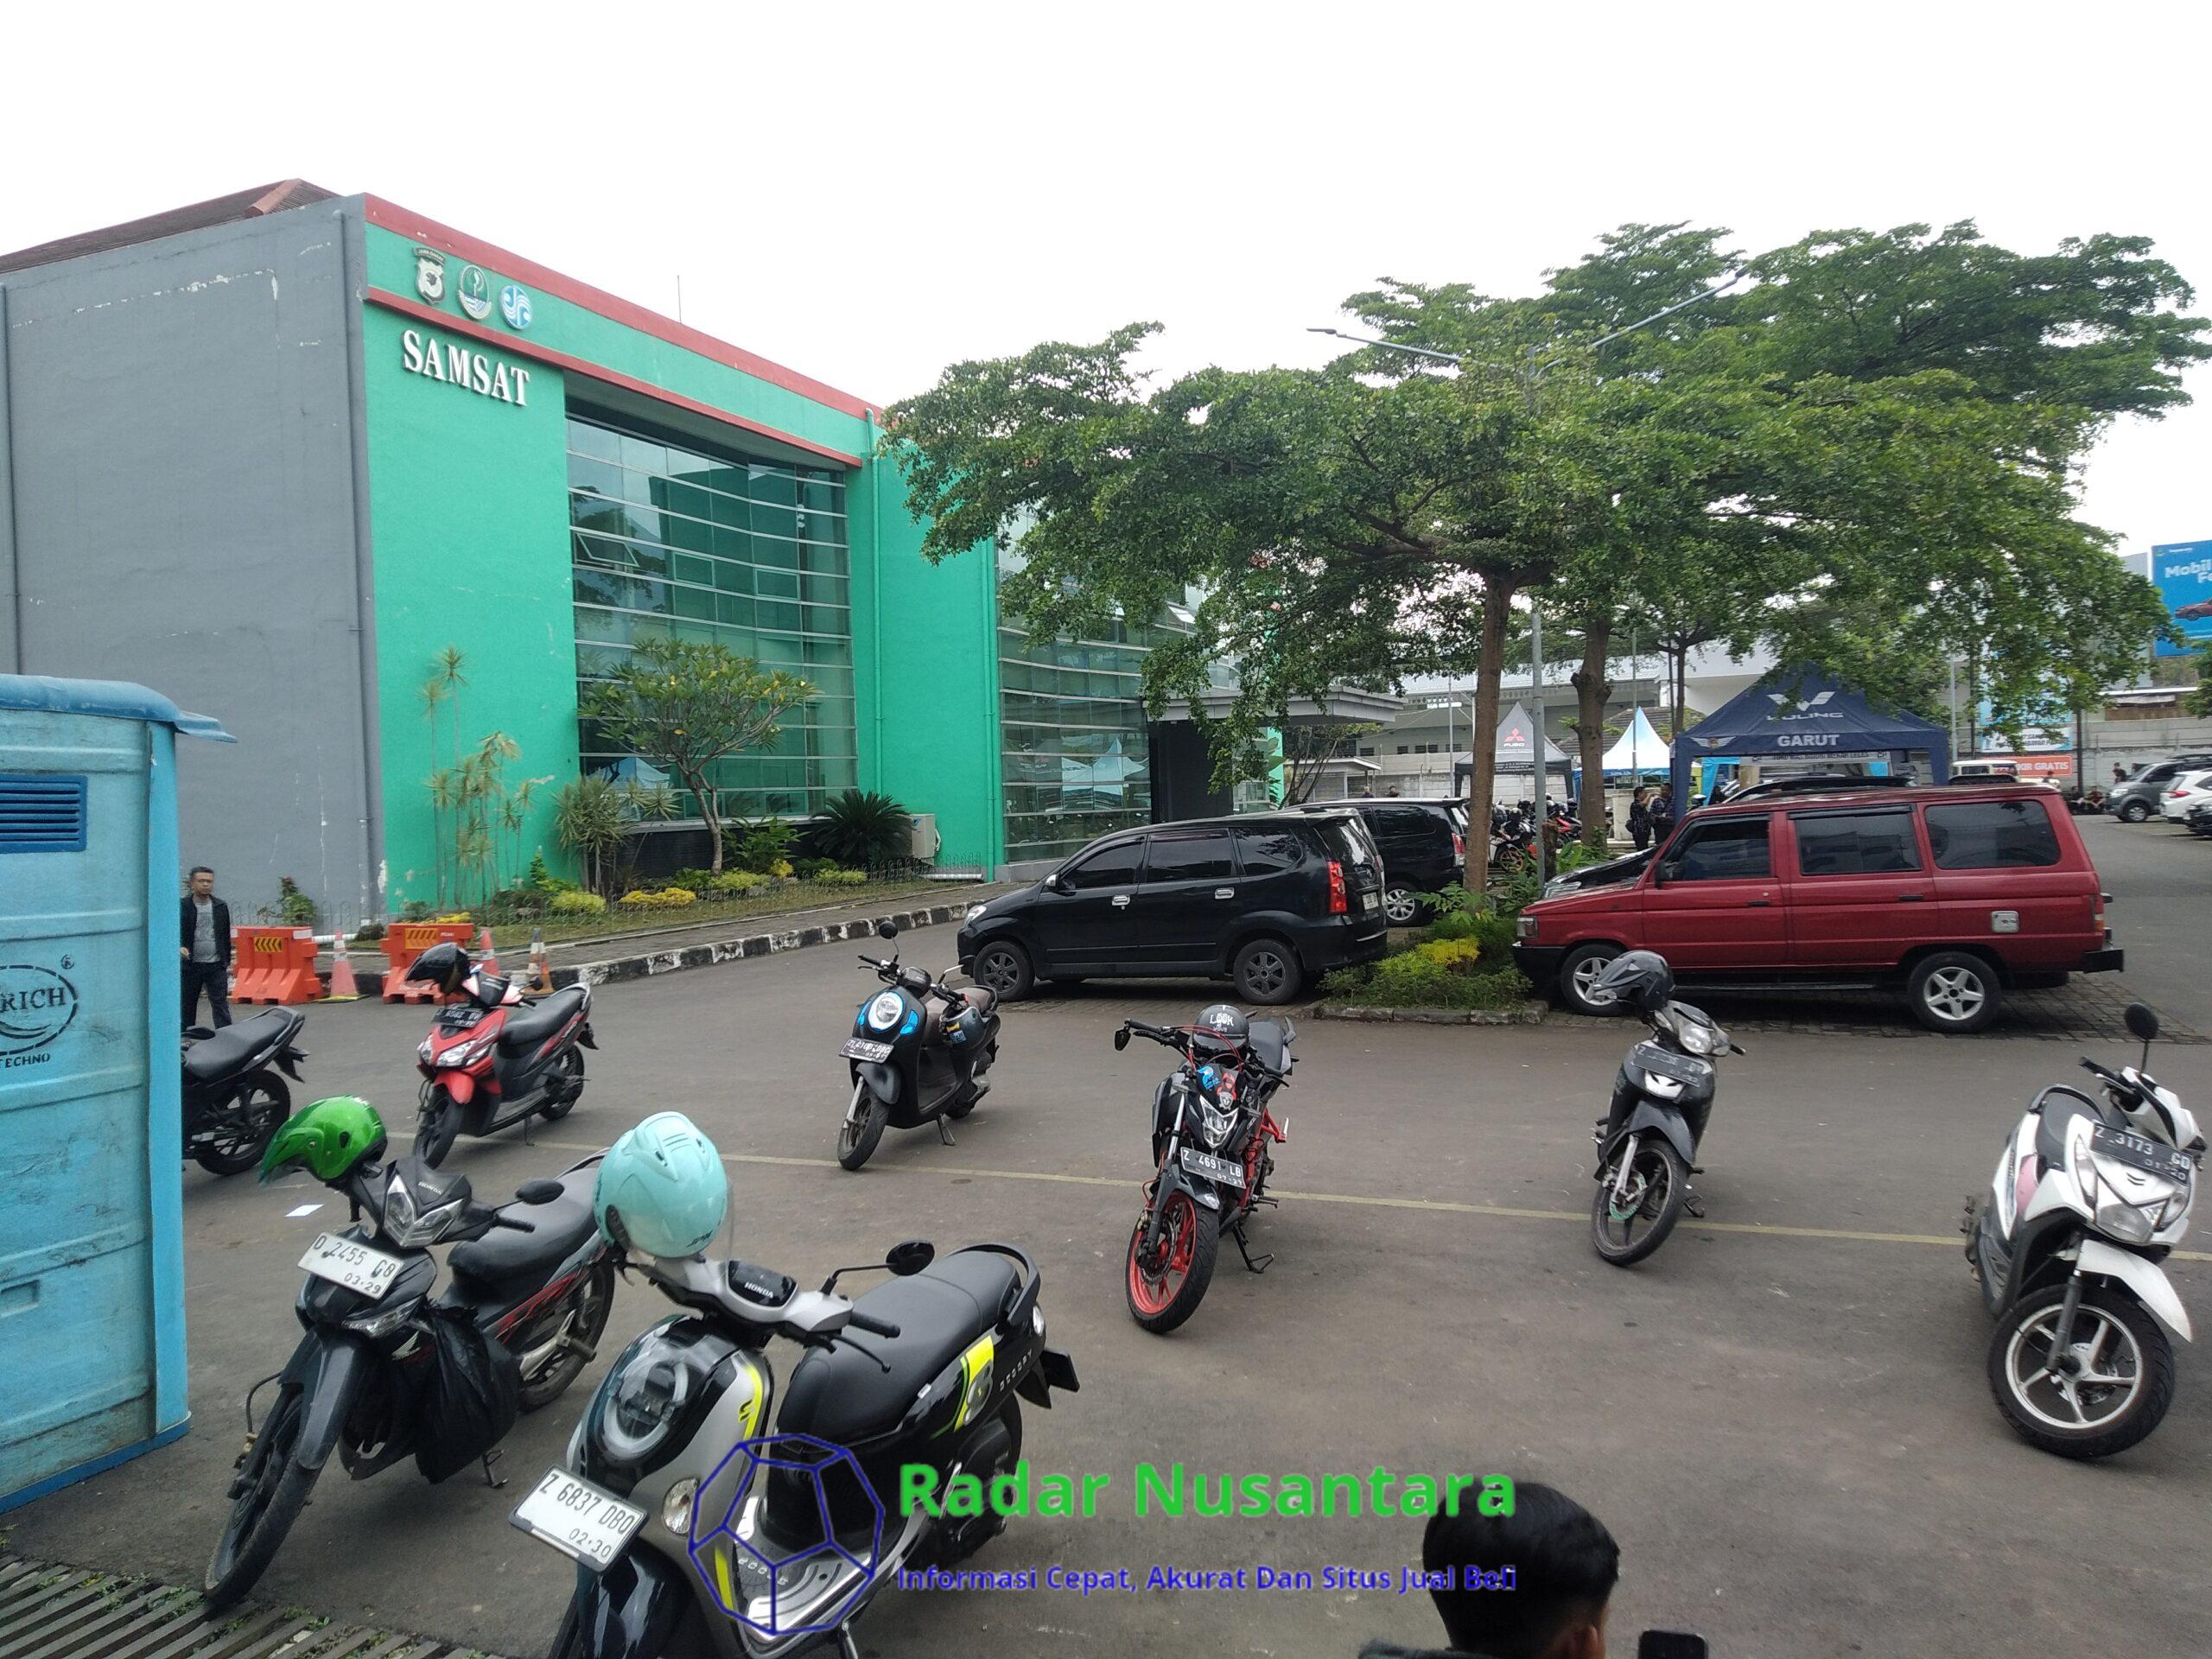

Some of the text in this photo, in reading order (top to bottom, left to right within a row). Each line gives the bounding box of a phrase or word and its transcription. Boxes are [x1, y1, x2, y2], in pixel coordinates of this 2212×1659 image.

[403, 329, 531, 406] SAMSAT
[1777, 734, 1840, 747] GARUT
[2034, 761, 2069, 772] GRATIS
[2094, 1125, 2106, 1139] Z
[2114, 1132, 2154, 1155] 3173
[1183, 1149, 1242, 1178] Z 4691 LB
[314, 1235, 327, 1250] D
[327, 1242, 368, 1266] 2455
[744, 1281, 774, 1299] HONDA
[538, 1472, 560, 1495] Z
[556, 1482, 602, 1516] 6837
